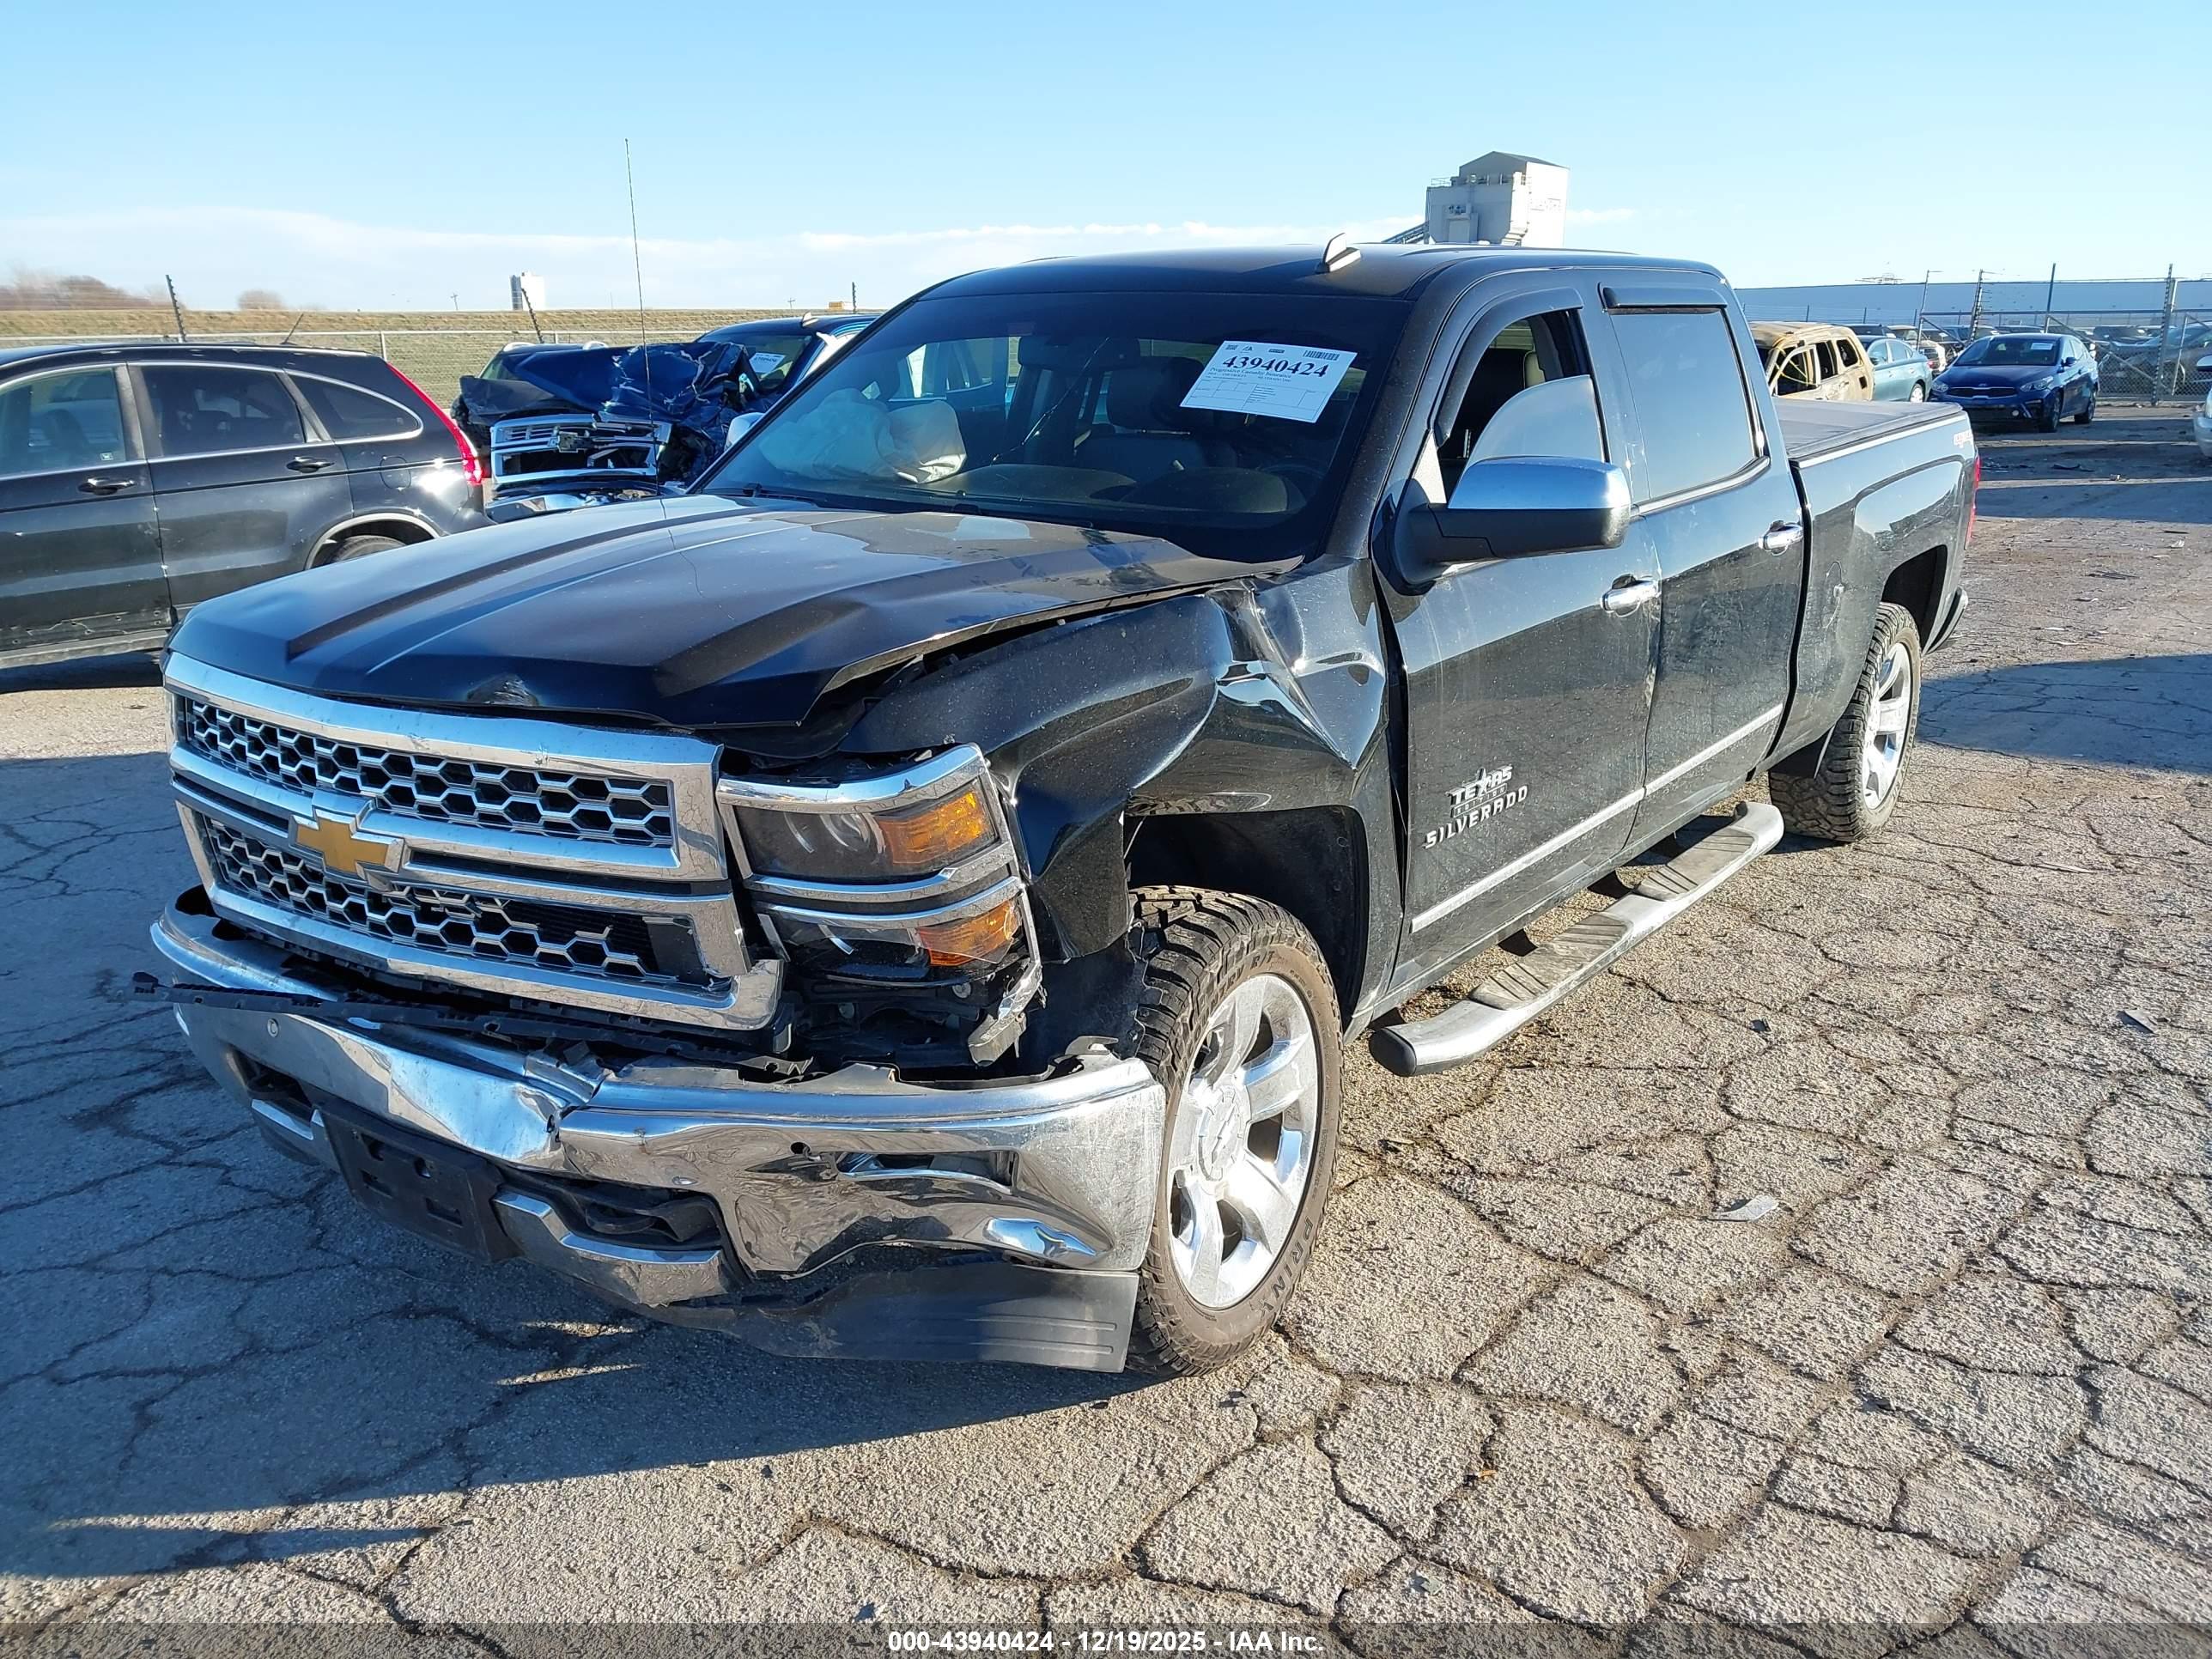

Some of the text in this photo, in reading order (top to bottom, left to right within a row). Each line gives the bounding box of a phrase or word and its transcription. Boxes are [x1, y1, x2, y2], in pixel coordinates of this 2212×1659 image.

[1223, 356, 1329, 378] 43940424
[1446, 764, 1513, 805] TEXAS
[1422, 785, 1528, 849] SILVERADO
